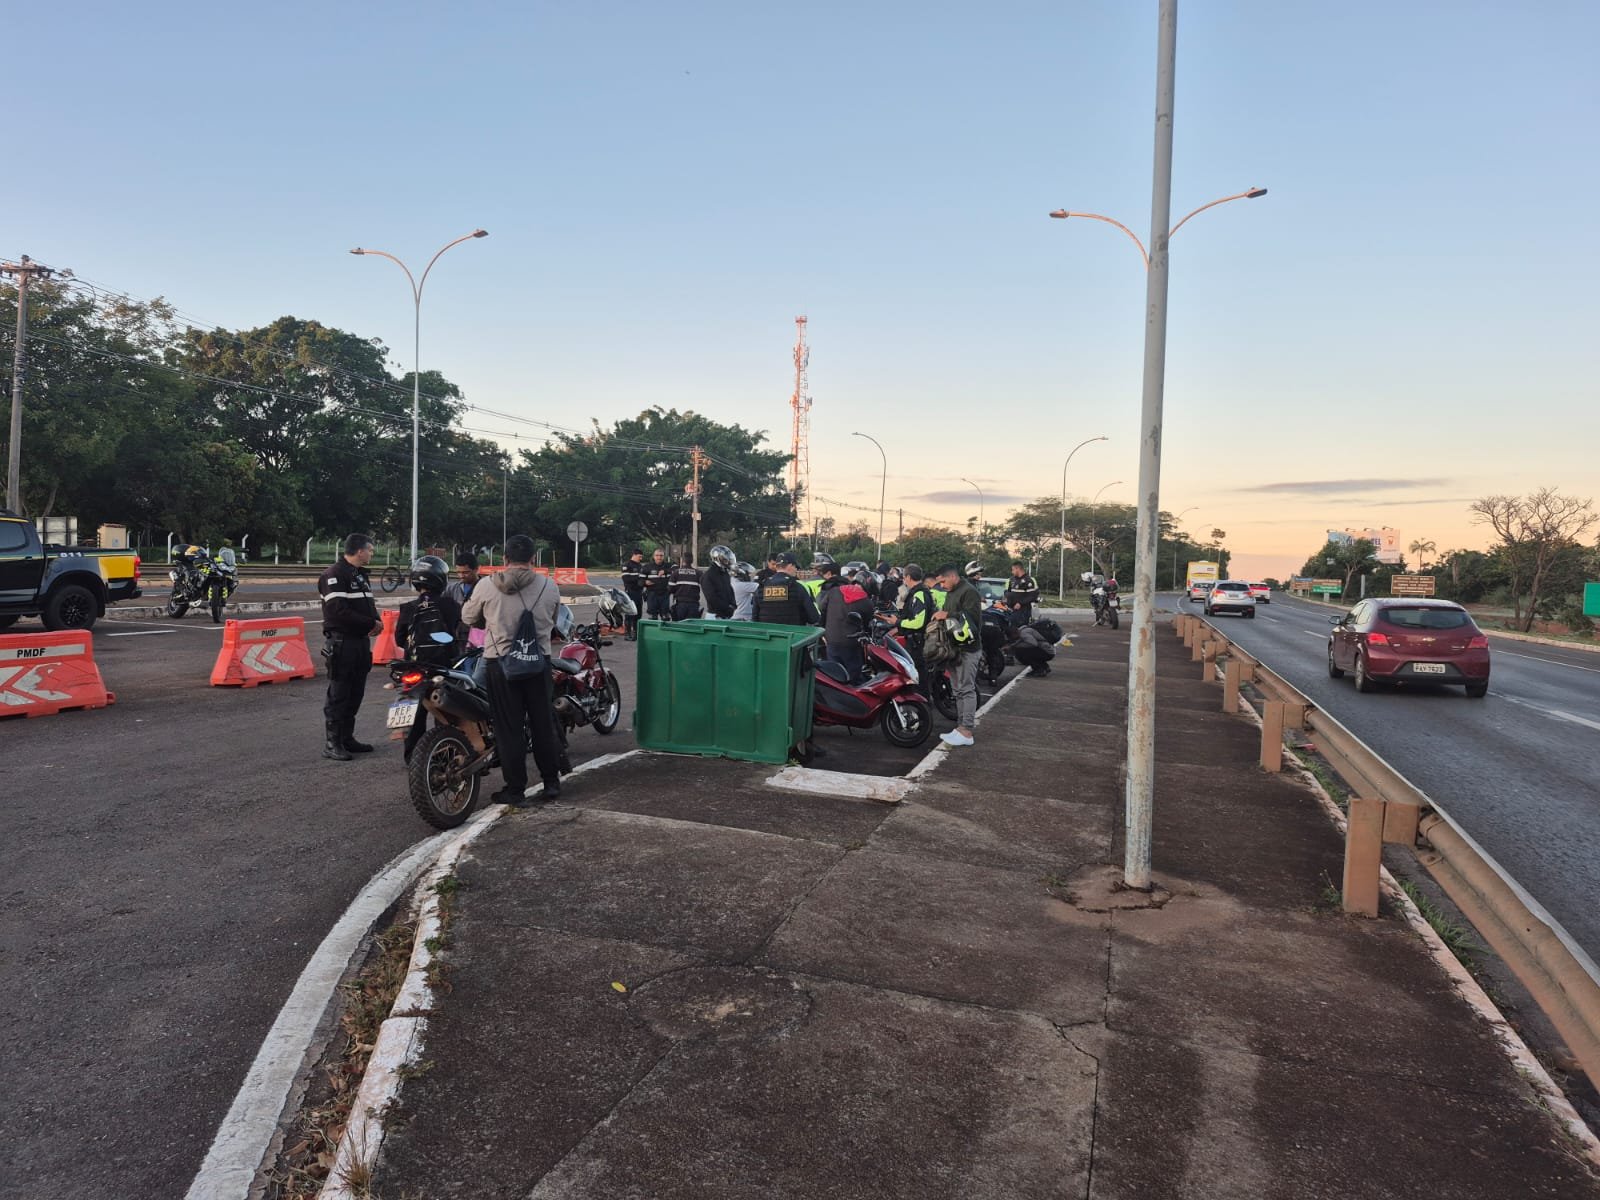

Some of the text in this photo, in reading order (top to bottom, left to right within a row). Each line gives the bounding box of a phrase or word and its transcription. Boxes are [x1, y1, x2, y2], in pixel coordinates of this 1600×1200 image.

[765, 587, 786, 597] DER
[261, 629, 277, 637] PMDF
[16, 647, 46, 659] PMDF
